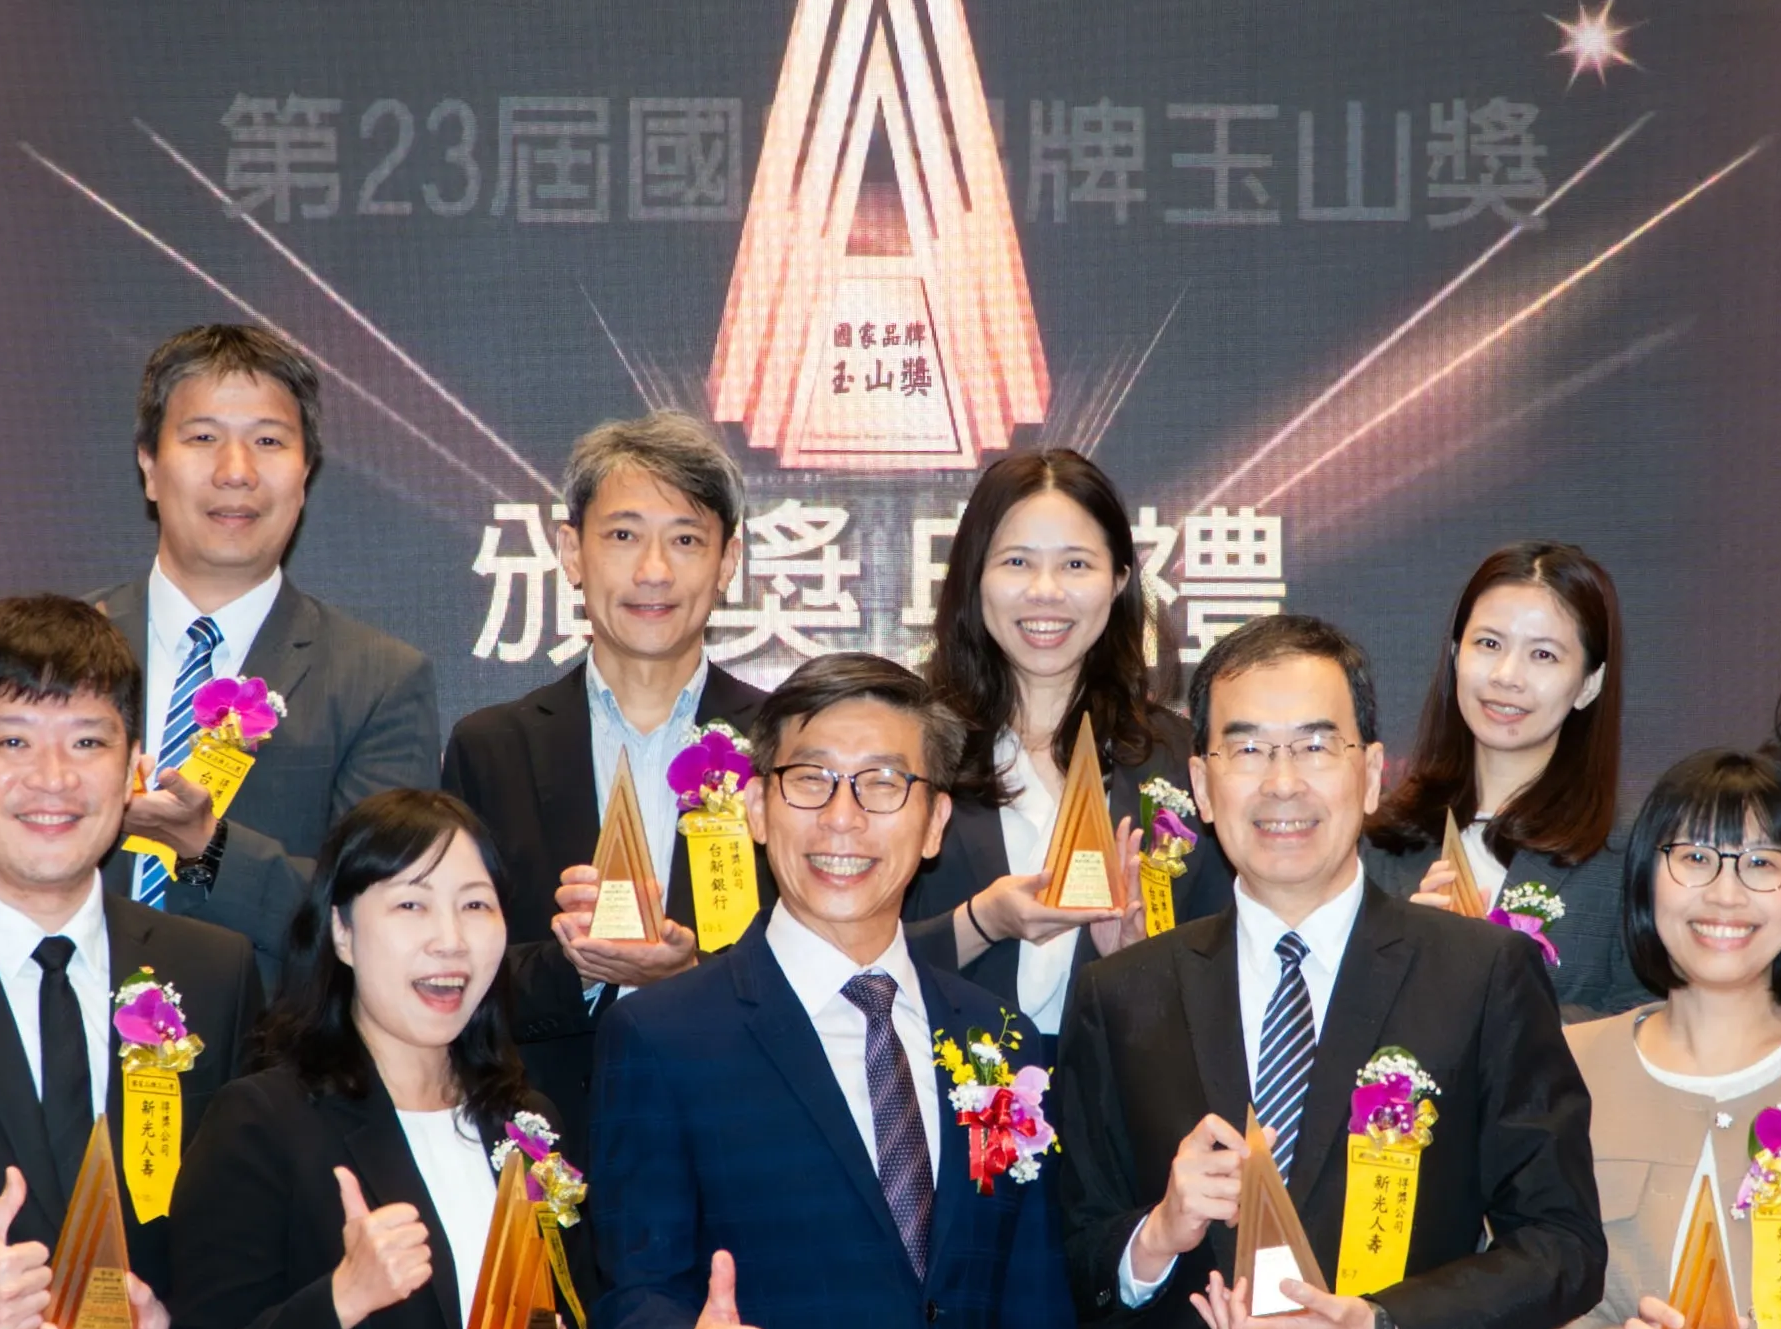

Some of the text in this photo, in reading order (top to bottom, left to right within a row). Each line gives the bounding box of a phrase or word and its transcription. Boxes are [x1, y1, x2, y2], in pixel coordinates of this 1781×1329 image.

[218, 90, 1549, 231] 第23屆國牌玉山獎
[830, 356, 933, 397] 玉山獎
[708, 842, 728, 911] 台新銀行
[140, 1099, 156, 1179] 新光人壽
[1365, 1174, 1391, 1255] 新光人壽
